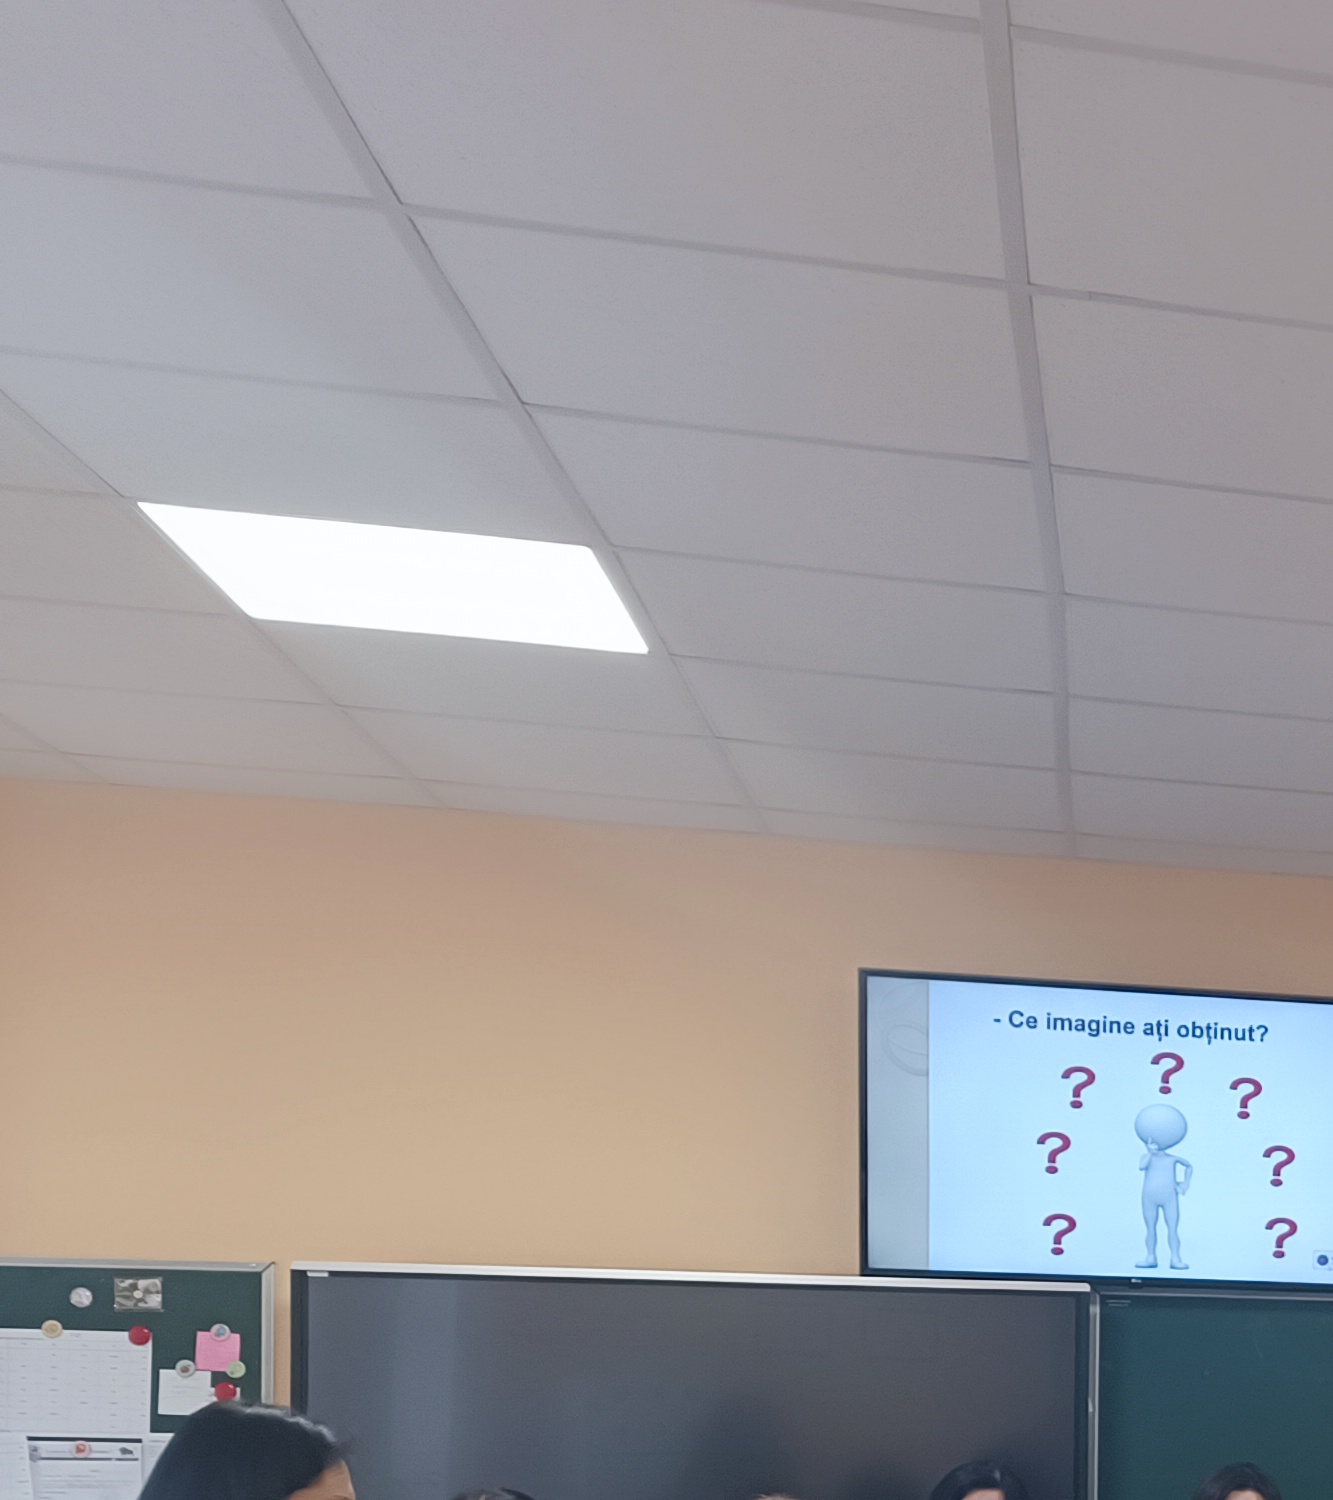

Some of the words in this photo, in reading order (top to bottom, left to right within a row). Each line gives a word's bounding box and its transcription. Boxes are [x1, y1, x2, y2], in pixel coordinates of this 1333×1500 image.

[1008, 1010, 1038, 1030] Ce
[1046, 1012, 1135, 1038] imagine
[1142, 1019, 1169, 1042] ați
[1176, 1021, 1269, 1045] obținut?
